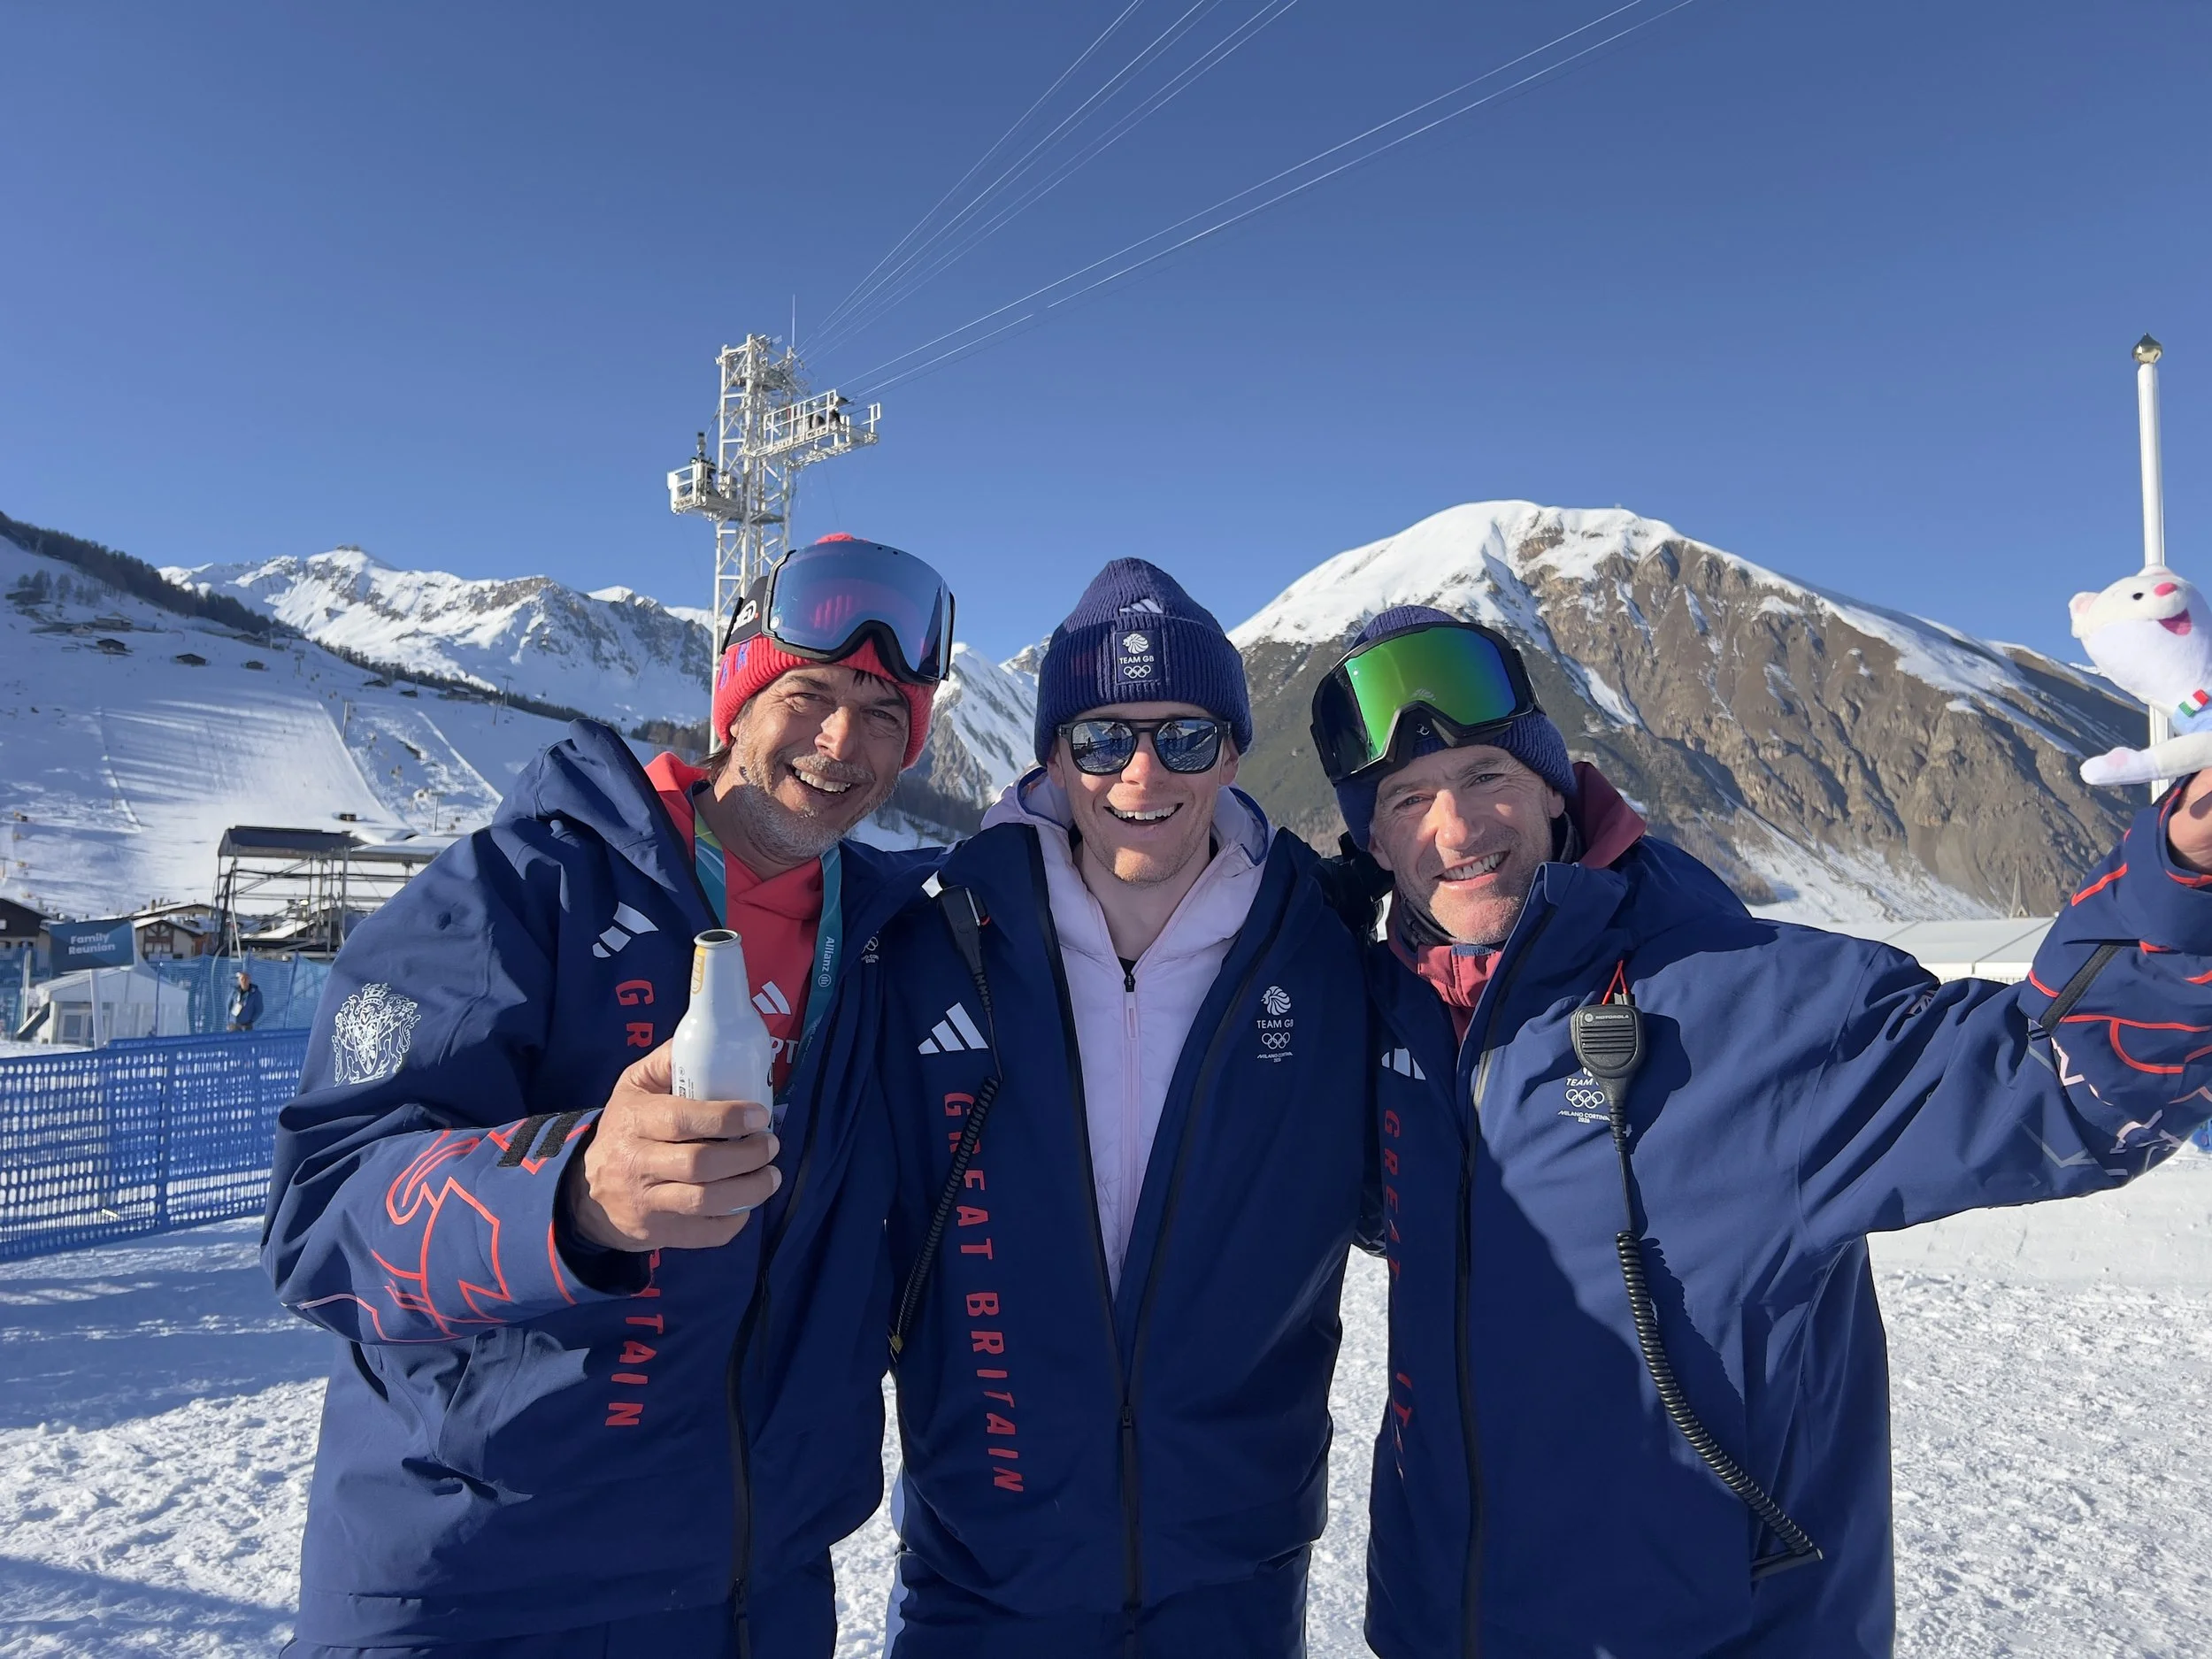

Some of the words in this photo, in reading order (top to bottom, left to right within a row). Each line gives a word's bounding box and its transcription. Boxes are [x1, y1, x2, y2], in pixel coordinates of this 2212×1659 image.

[71, 933, 111, 944] Family
[68, 943, 116, 955] Reunion
[822, 936, 835, 972] Allianz
[1256, 1019, 1282, 1028] TEAM
[1566, 1078, 1594, 1087] TEAM
[1584, 1112, 1610, 1121] CORTINA
[965, 1292, 1025, 1493] BRITAIN
